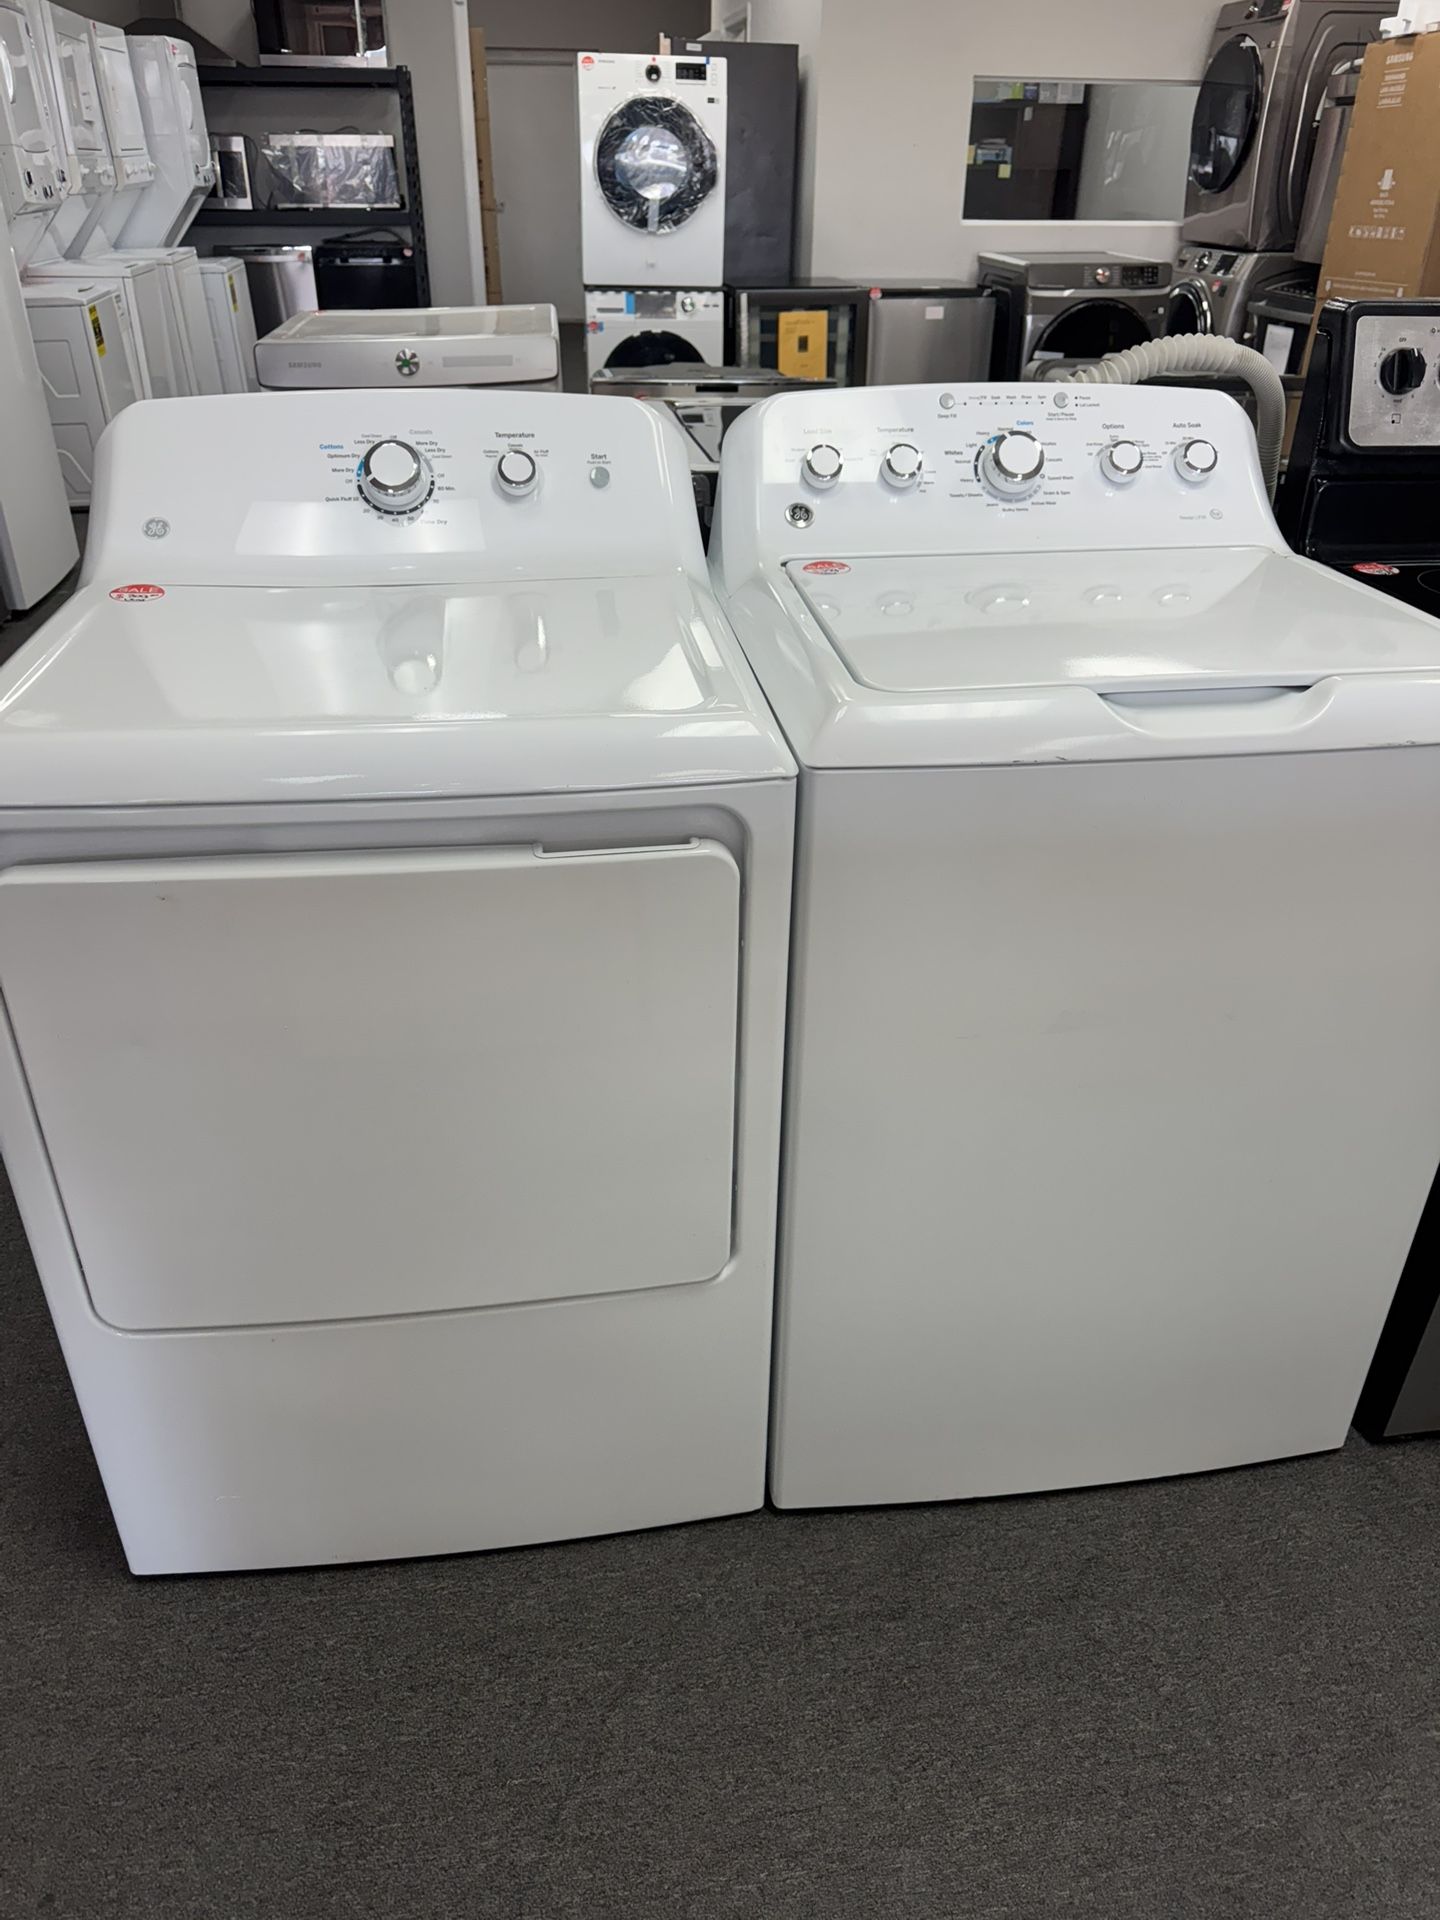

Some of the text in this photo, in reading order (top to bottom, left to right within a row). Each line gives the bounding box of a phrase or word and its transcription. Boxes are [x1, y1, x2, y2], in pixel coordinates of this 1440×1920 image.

[288, 361, 322, 369] SAMSUNG
[877, 426, 914, 434] Temperature
[495, 431, 535, 439] Temperature
